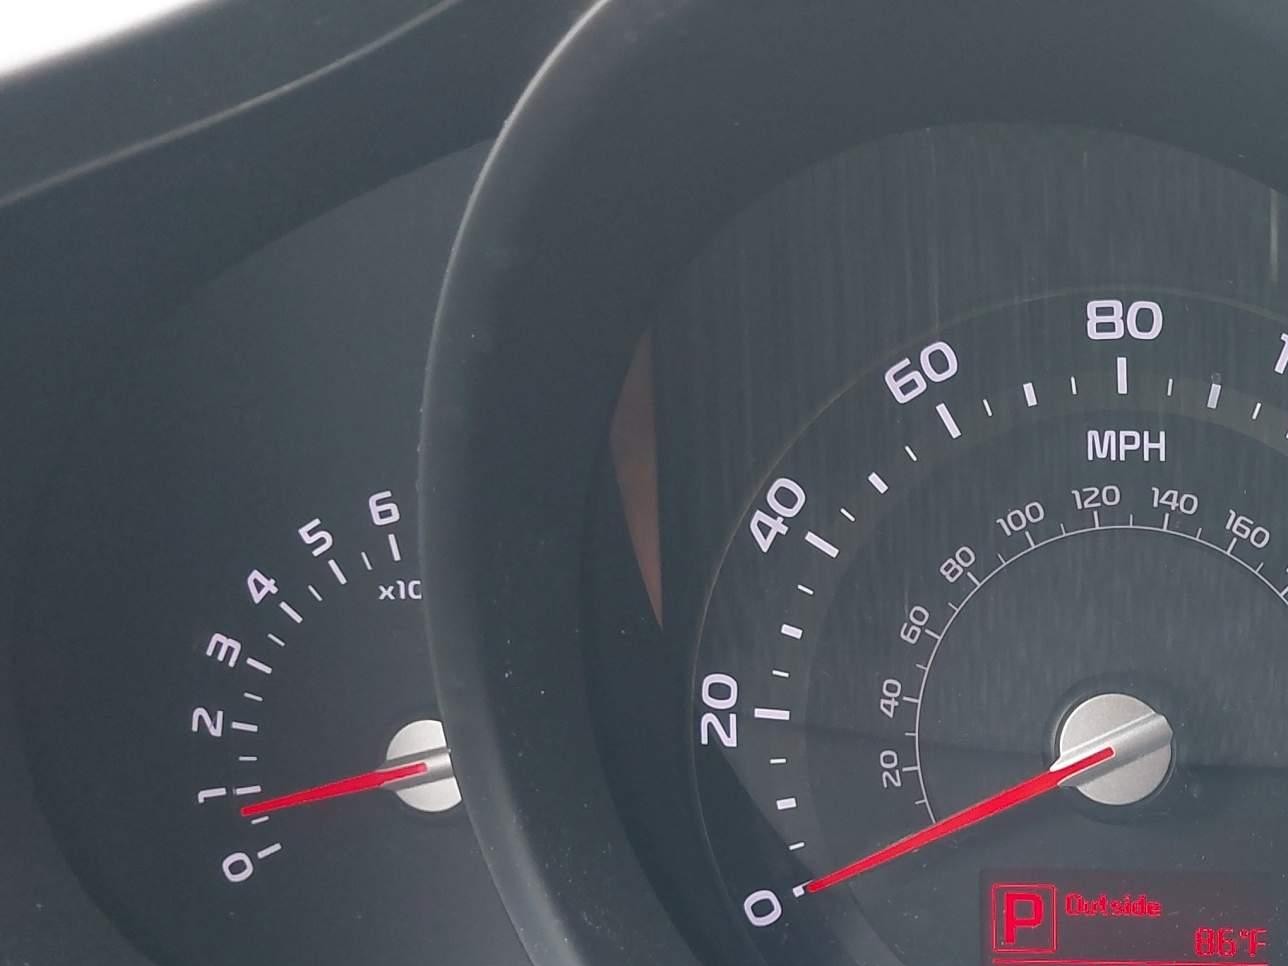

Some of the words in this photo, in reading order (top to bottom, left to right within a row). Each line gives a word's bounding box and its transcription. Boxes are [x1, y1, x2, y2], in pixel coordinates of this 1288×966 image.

[1087, 300, 1163, 340] 80
[885, 341, 958, 404] 60
[1087, 430, 1167, 462] MPH
[368, 490, 400, 526] 6
[749, 478, 806, 553] 40
[1071, 485, 1121, 510] 120
[1151, 487, 1199, 515] 140
[996, 501, 1046, 537] 100
[1224, 509, 1270, 549] 160
[298, 518, 334, 558] 5
[939, 546, 976, 583] 80
[246, 569, 280, 604] 4
[900, 605, 930, 645] 60
[206, 632, 242, 668] 3
[701, 673, 738, 748] 20
[879, 678, 902, 718] 40
[191, 707, 224, 737] 2
[879, 749, 902, 788] 20
[197, 787, 227, 803] 1
[222, 852, 254, 882] 0
[743, 889, 783, 927] 0
[1004, 892, 1044, 944] P
[1064, 893, 1161, 918] Outside
